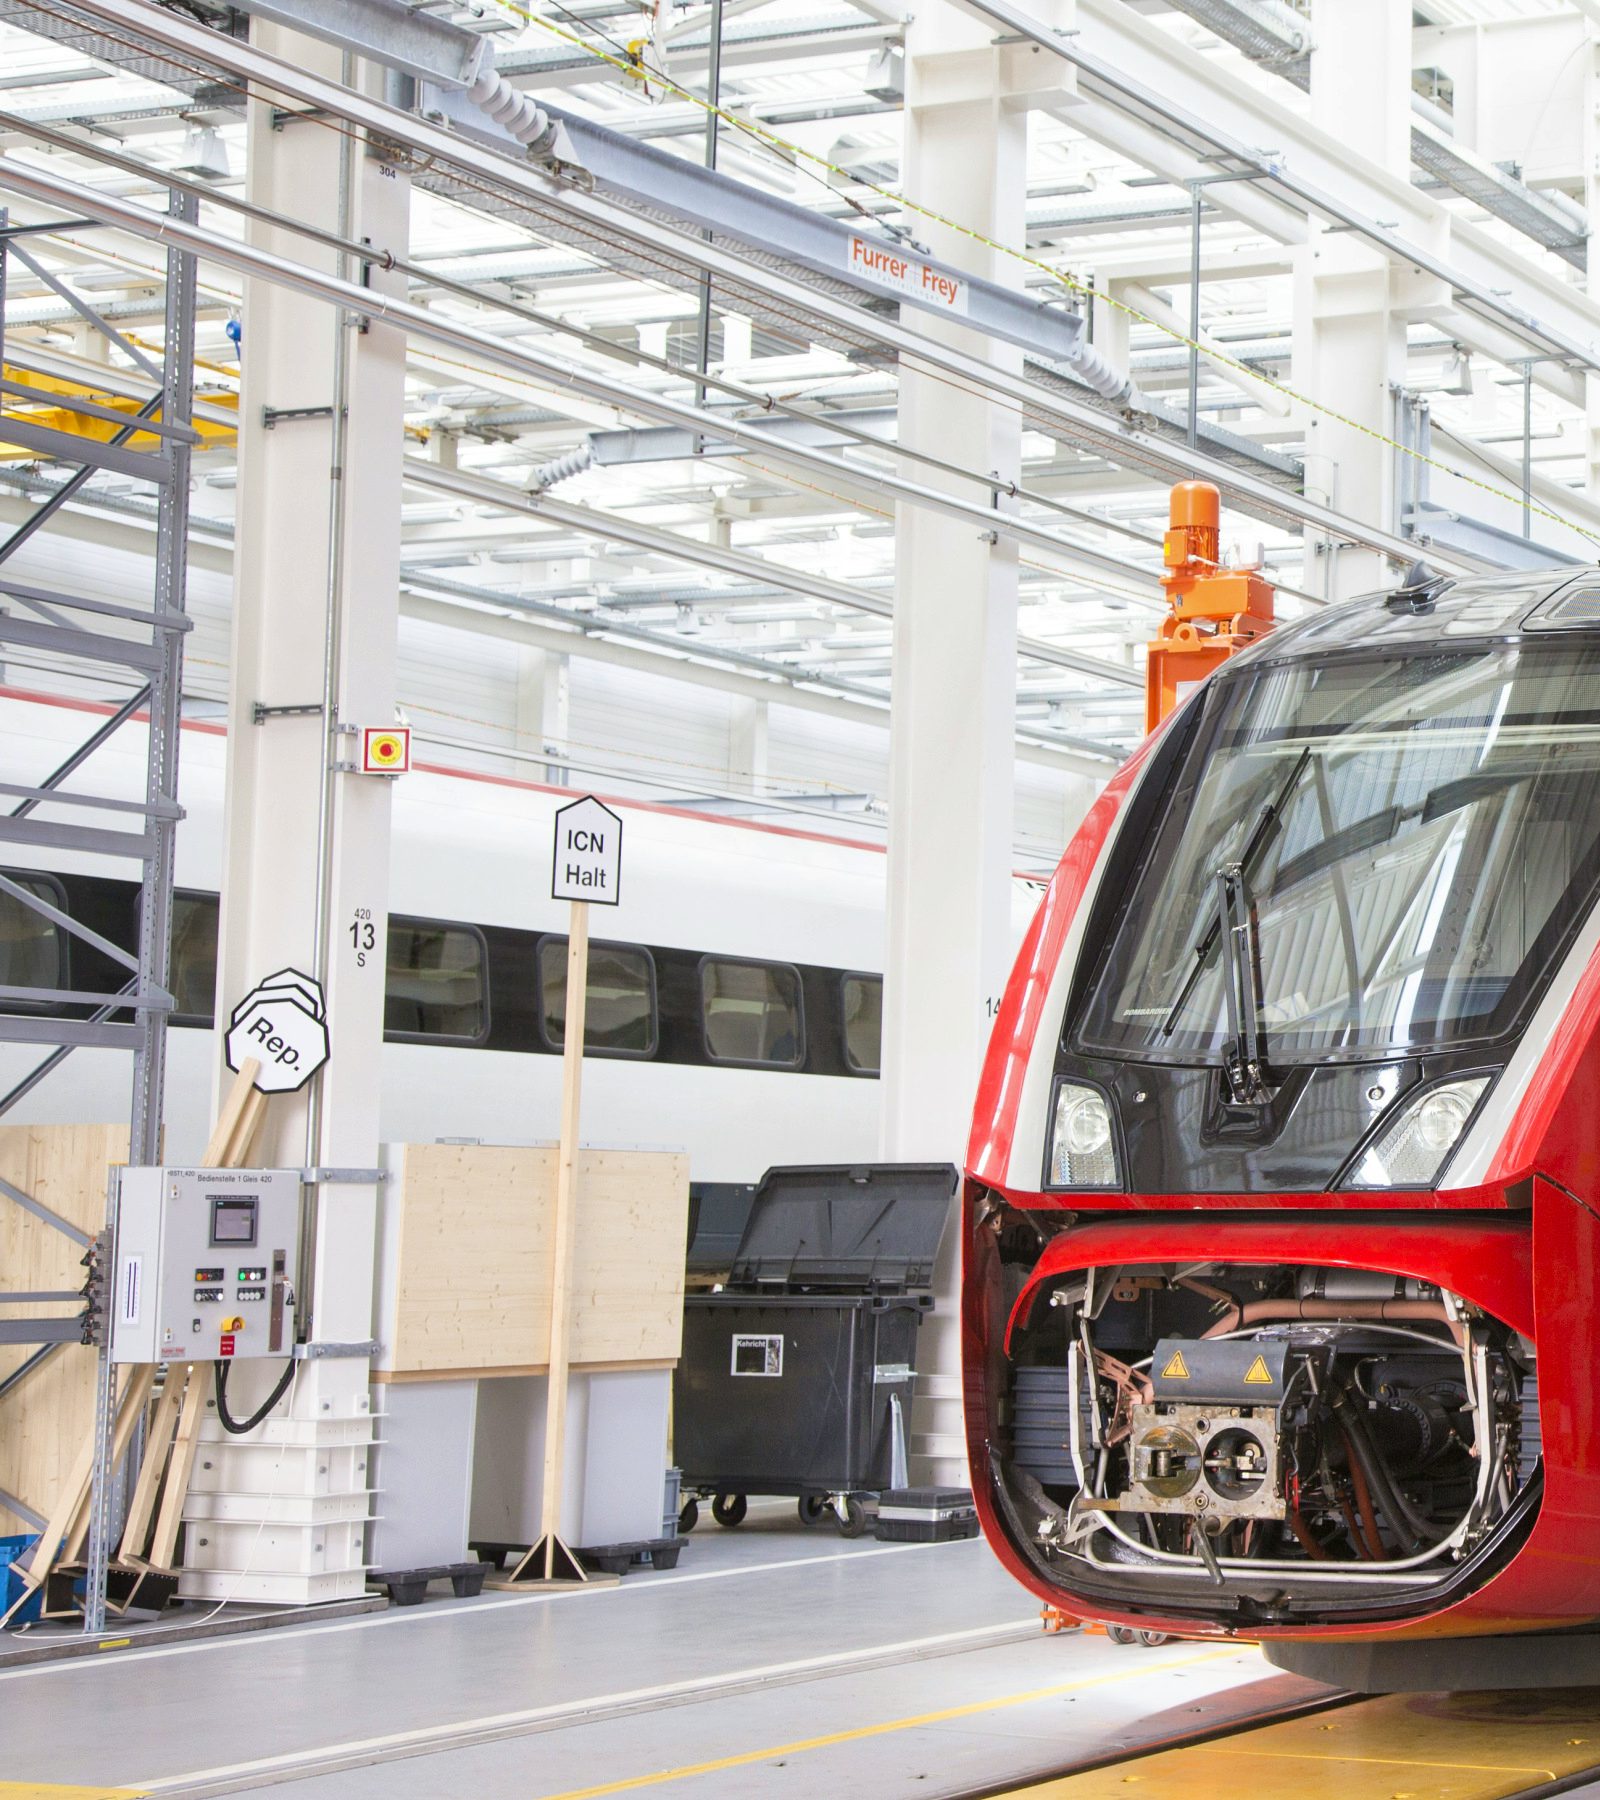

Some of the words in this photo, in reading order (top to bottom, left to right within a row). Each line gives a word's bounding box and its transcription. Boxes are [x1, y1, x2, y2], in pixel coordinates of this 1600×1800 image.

[379, 164, 396, 179] 304
[852, 238, 908, 279] Furrer
[922, 265, 958, 304] Frey
[568, 829, 604, 854] ICN
[565, 863, 607, 888] Halt
[354, 908, 371, 920] 420
[350, 921, 375, 950] 13
[356, 952, 366, 967] S
[247, 1016, 300, 1072] Rep.
[197, 1175, 236, 1183] Bedienstelle
[737, 1340, 766, 1348] Kehricht
